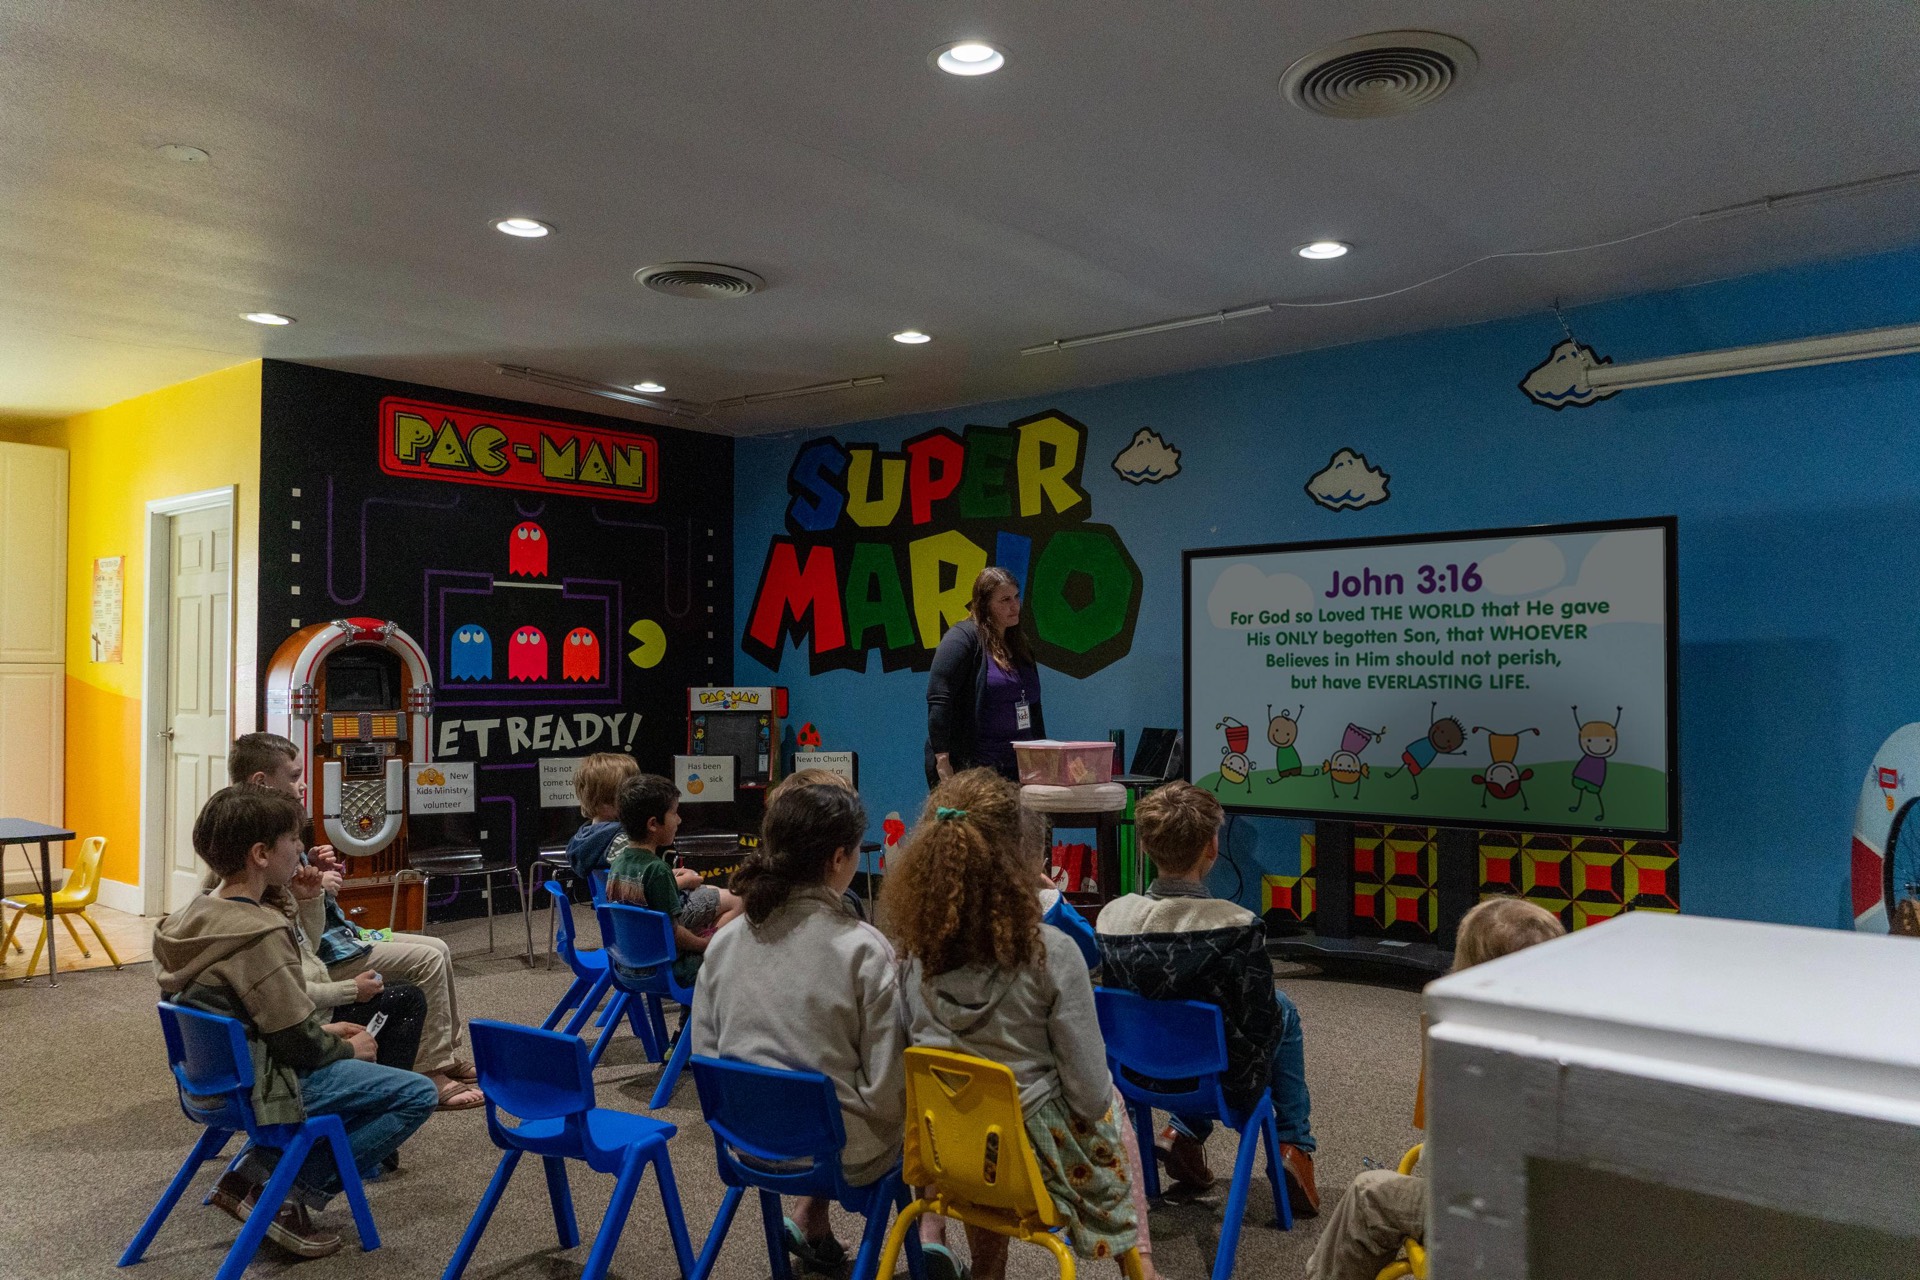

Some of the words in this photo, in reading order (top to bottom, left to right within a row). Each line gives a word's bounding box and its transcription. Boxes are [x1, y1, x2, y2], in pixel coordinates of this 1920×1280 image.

[395, 412, 645, 489] PAC-MAN
[790, 416, 1083, 531] SUPER
[1325, 567, 1403, 598] John
[1417, 562, 1483, 594] 3:16
[1231, 611, 1254, 626] For
[1259, 608, 1290, 625] God
[1296, 611, 1313, 624] so
[1319, 607, 1365, 623] Loved
[1371, 605, 1402, 621] THE
[1409, 603, 1474, 620] WORLD
[1481, 602, 1520, 618] that
[1527, 600, 1554, 616] He
[1561, 599, 1609, 620] gave
[1247, 631, 1270, 646] His
[1276, 631, 1318, 645] ONLY
[1323, 629, 1398, 648] begotten
[1404, 628, 1440, 647] Son,
[1447, 627, 1483, 642] that
[1490, 624, 1587, 641] WHOEVER
[1266, 652, 1329, 667] Believes
[1335, 652, 1350, 667] in
[1356, 651, 1389, 666] Him
[1396, 650, 1454, 666] should
[1461, 650, 1491, 665] not
[1498, 649, 1562, 669] perish,
[1291, 675, 1317, 689] but
[1322, 675, 1361, 689] have
[1367, 674, 1482, 689] EVERLASTING
[1490, 674, 1529, 689] LIFE.
[432, 718, 500, 758] ET
[506, 712, 643, 755] READY!
[559, 765, 572, 773] not
[709, 775, 724, 783] sick
[416, 787, 432, 795] Kids
[434, 786, 468, 795] Ministry
[549, 792, 575, 801] church
[423, 801, 461, 809] volunteer
